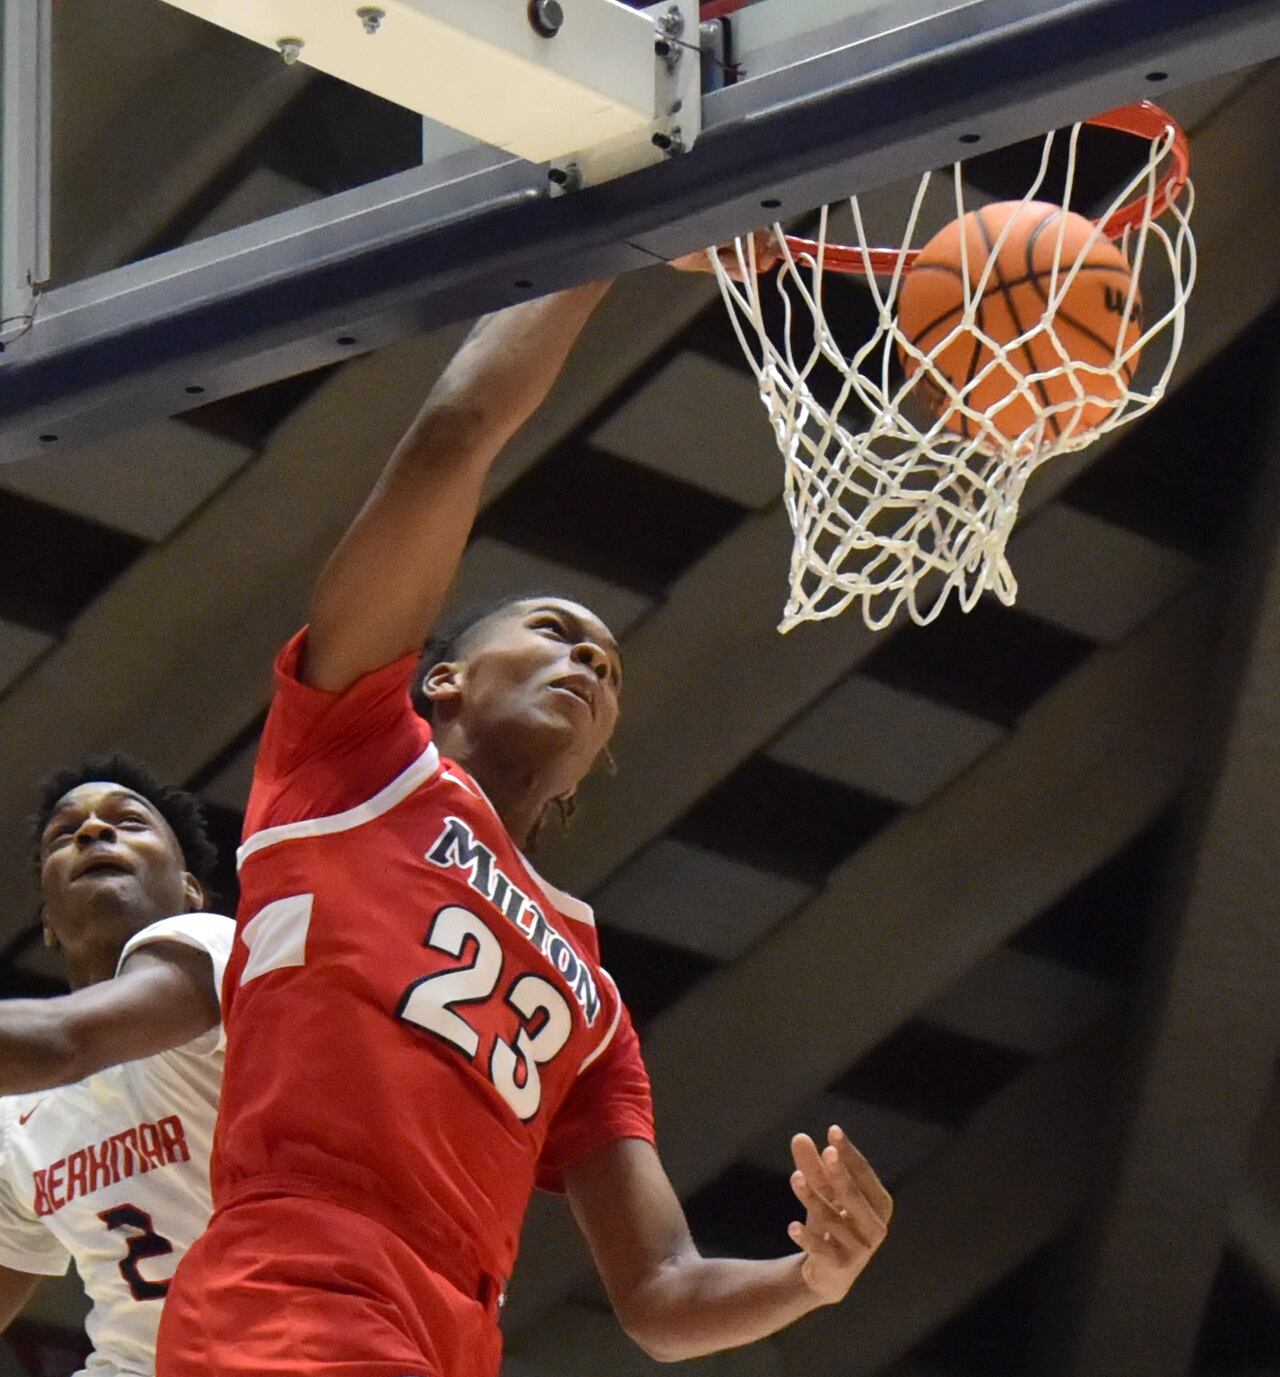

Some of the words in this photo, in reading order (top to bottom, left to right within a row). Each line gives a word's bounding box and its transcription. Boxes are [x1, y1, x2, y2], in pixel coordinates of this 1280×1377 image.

[424, 816, 601, 1028] MILTON
[395, 904, 572, 1124] 23
[32, 1115, 191, 1217] BERKMAR
[96, 1203, 173, 1302] 2
